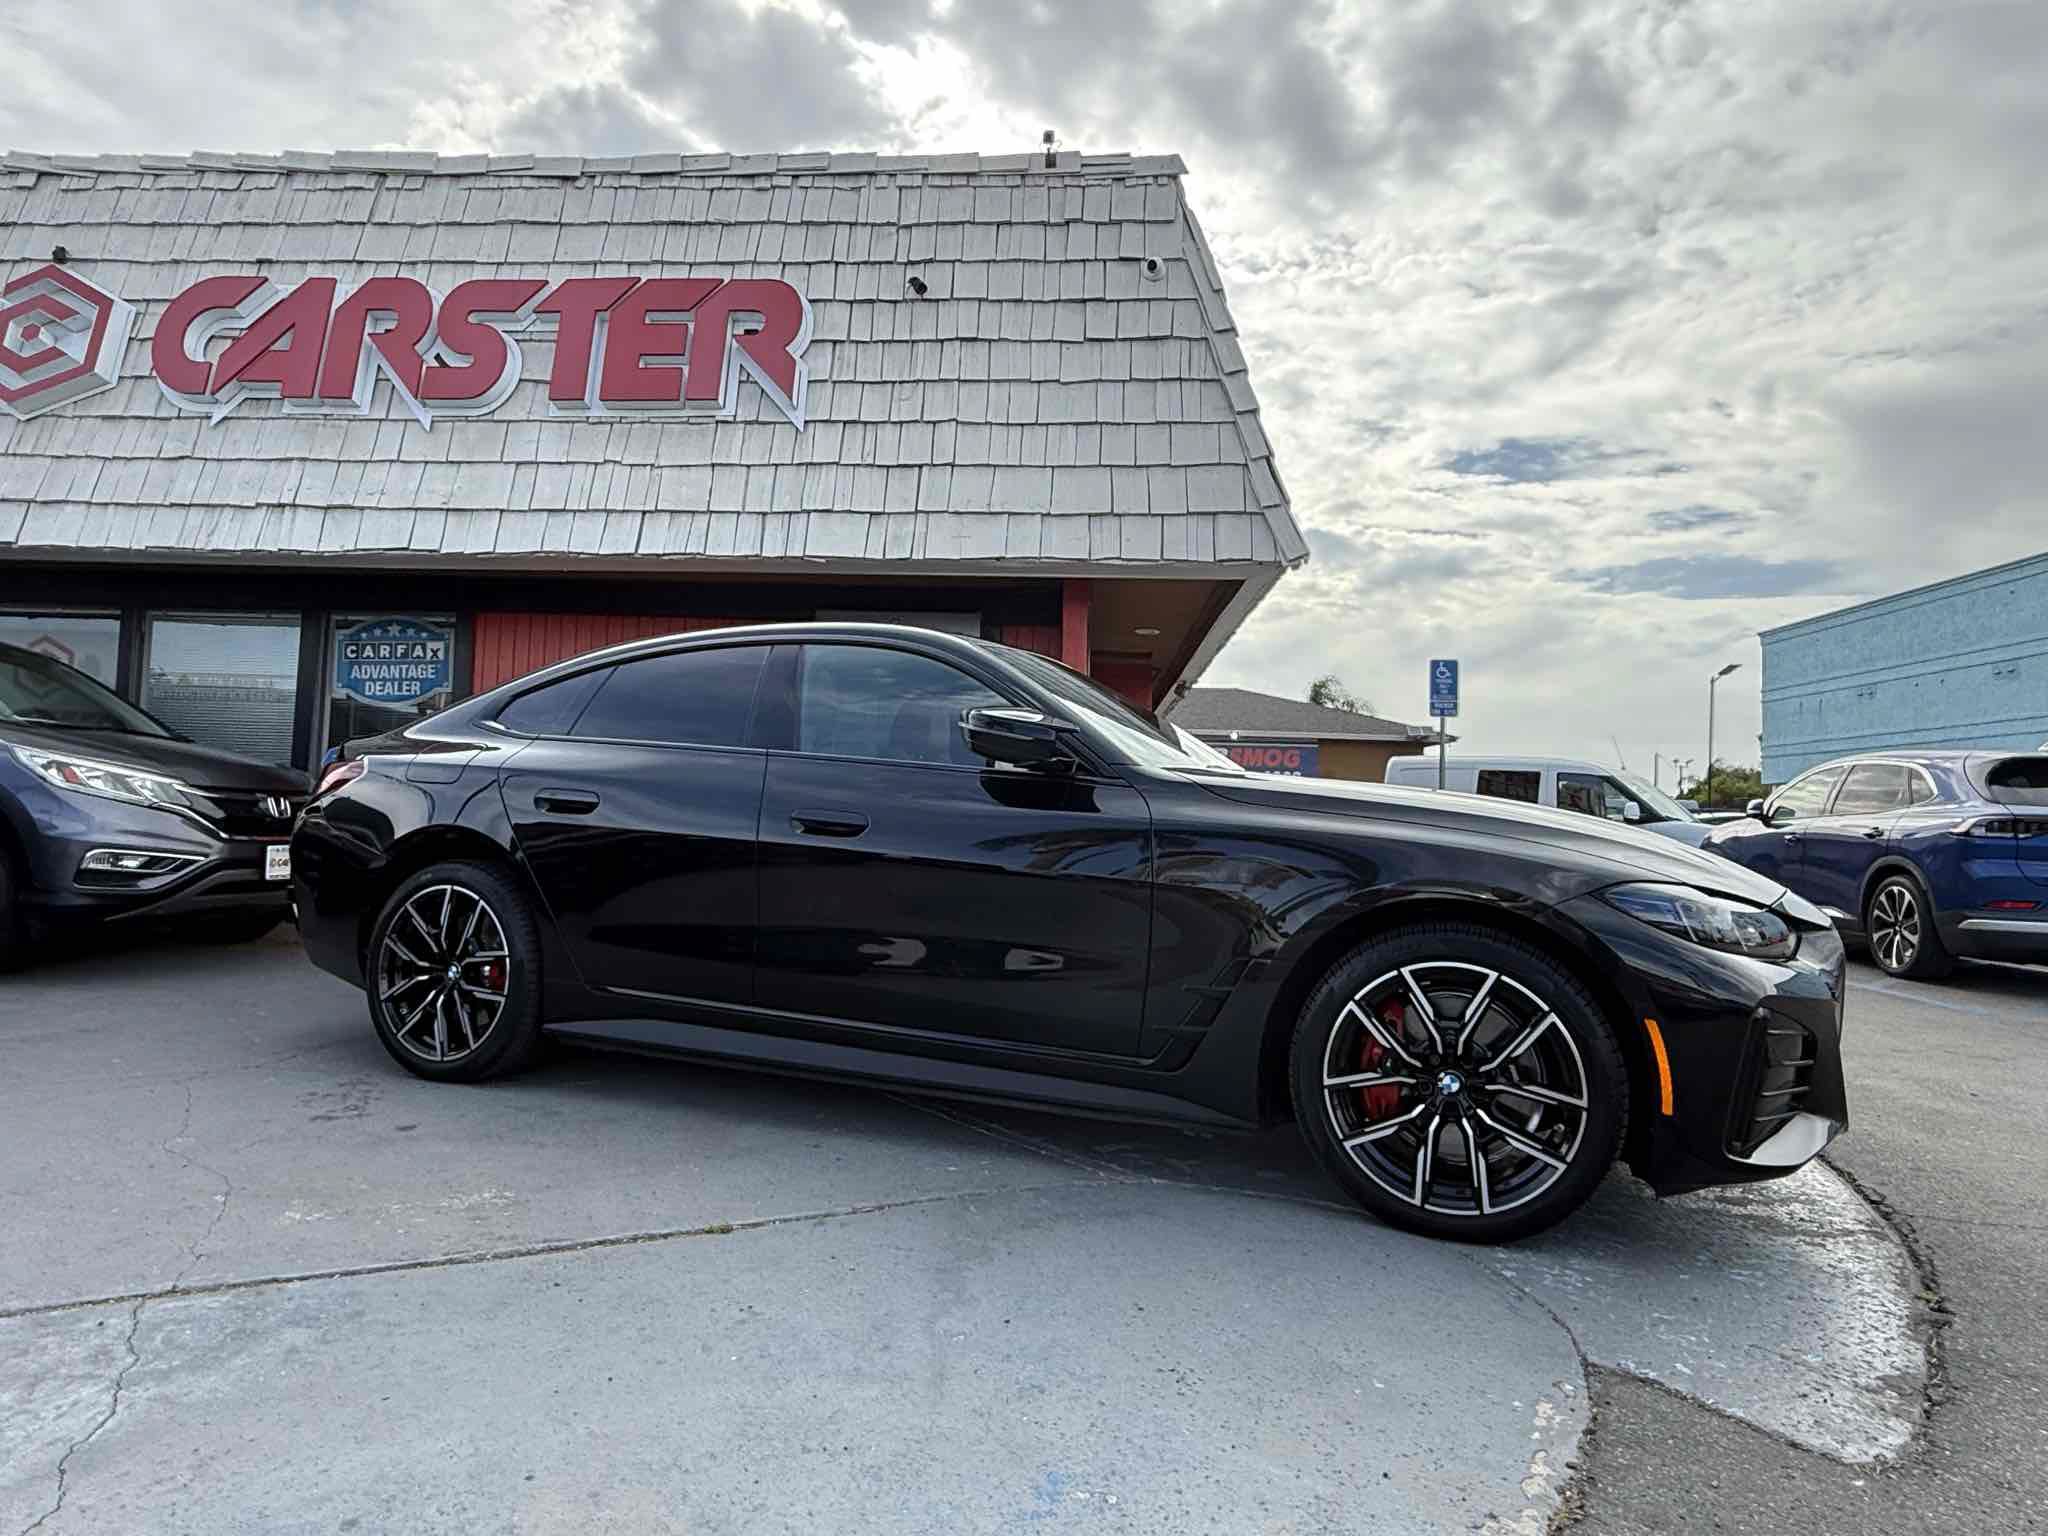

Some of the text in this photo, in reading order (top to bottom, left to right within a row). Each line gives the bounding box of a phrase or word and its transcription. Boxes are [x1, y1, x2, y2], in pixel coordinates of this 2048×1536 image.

[151, 276, 812, 428] CARSTER
[345, 643, 442, 660] CARFAX
[350, 664, 437, 680] ADVANTAGE
[364, 681, 421, 696] DEALER
[1230, 747, 1301, 769] SMOG
